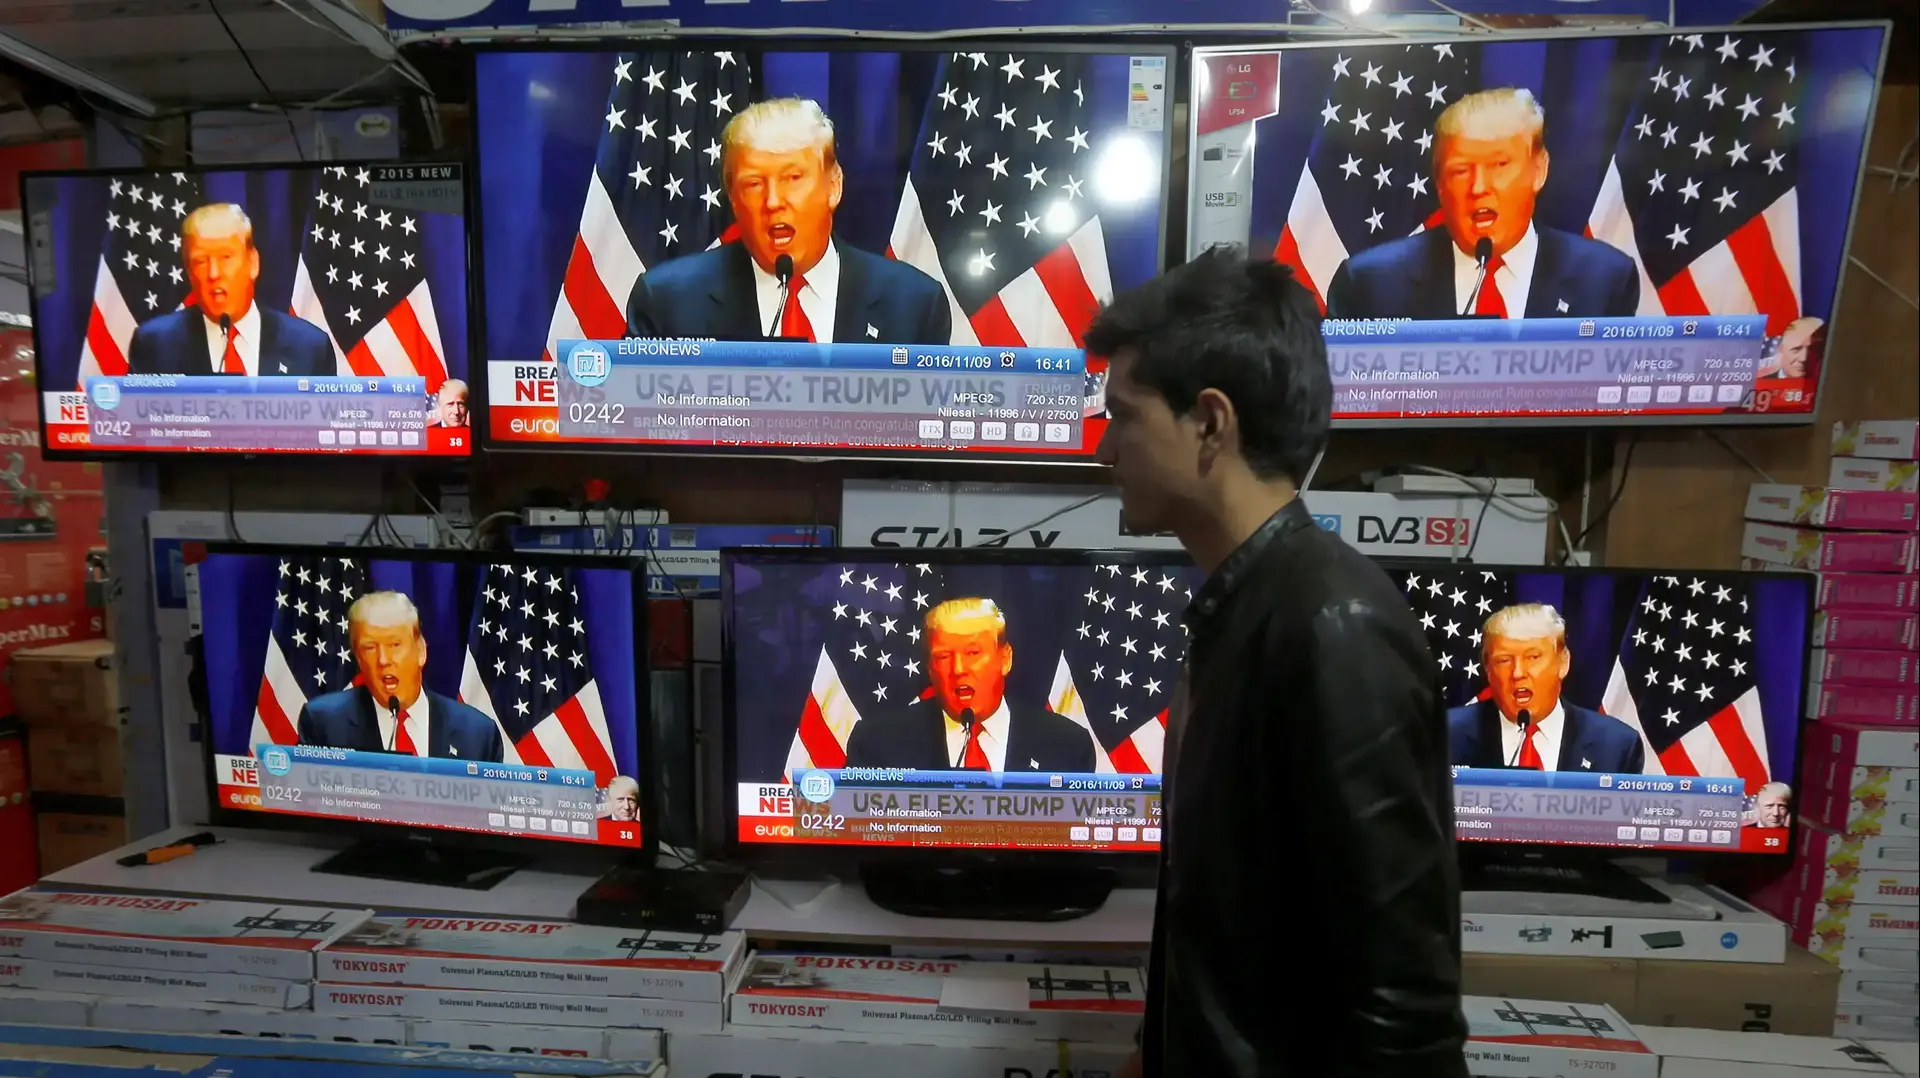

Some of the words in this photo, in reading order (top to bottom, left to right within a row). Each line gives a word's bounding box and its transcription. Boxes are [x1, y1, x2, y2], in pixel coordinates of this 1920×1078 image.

[380, 168, 414, 179] 2015
[421, 167, 452, 178] NEW
[1603, 326, 1674, 338] 2016/11/09
[1716, 325, 1750, 336] 16:41
[618, 344, 700, 356] EURONEWS
[917, 355, 991, 369] 2016/11/09
[1036, 358, 1070, 370] 16:41
[1491, 348, 1593, 375] TRUMP
[1635, 360, 1673, 370] MPEG2
[1704, 359, 1721, 368] 720
[1350, 370, 1366, 380] No
[1372, 368, 1439, 380] Information
[1618, 374, 1654, 384] Nilesat
[1722, 372, 1752, 382] 27500
[315, 383, 364, 394] 2016/11/09
[392, 384, 416, 393] 16:41
[636, 374, 696, 400] USA
[803, 375, 910, 406] TRUMP
[1350, 389, 1366, 400] No
[1370, 388, 1438, 400] Information
[657, 392, 675, 405] No
[680, 394, 750, 407] Information
[954, 393, 994, 404] MPEG2
[1027, 395, 1045, 404] 720
[1058, 396, 1077, 406] 576
[242, 401, 312, 421] TRUMP
[340, 410, 366, 419] MPEG2
[388, 410, 400, 418] 720
[409, 410, 422, 418] 576
[569, 403, 625, 424] 0242
[938, 408, 976, 418] Nilesat
[988, 408, 1018, 418] 11996
[1048, 410, 1078, 420] 27500
[150, 414, 163, 423] No
[164, 414, 210, 424] Information
[657, 412, 675, 426] No
[680, 414, 750, 427] Information
[94, 421, 132, 436] 0242
[402, 422, 424, 430] 27500
[150, 428, 164, 437] No
[165, 428, 211, 438] Information
[450, 438, 462, 446] 38
[1358, 516, 1420, 544] DVB
[1430, 520, 1466, 544] S2
[484, 769, 532, 780] 2016/11/09
[562, 776, 585, 786] 16:41
[840, 772, 904, 781] EURONEWS
[1069, 780, 1125, 790] 2016/11/09
[320, 784, 332, 792] No
[335, 784, 380, 796] Information
[412, 778, 481, 802] TRUMP
[1618, 780, 1674, 791] 2016/11/09
[1706, 784, 1732, 793] 16:41
[266, 786, 302, 802] 0242
[322, 797, 334, 806] No
[336, 798, 380, 810] Information
[509, 796, 536, 805] MPEG2
[578, 802, 592, 810] 576
[854, 793, 898, 812] USA
[982, 796, 1064, 817] TRUMP
[1534, 794, 1612, 816] TRUMP
[572, 812, 593, 820] 27500
[870, 808, 884, 817] No
[887, 808, 942, 818] Information
[1097, 807, 1128, 815] MPEG2
[1645, 808, 1674, 816] MPEG2
[1722, 810, 1737, 818] 576
[801, 814, 844, 830] 0242
[870, 823, 884, 832] No
[887, 823, 942, 833] Information
[1085, 818, 1114, 826] Nilesat
[1122, 818, 1146, 826] 11996
[1713, 820, 1738, 828] 27500
[620, 831, 633, 840] 38
[1764, 838, 1779, 846] 38
[50, 893, 198, 912] TOKYOSAT
[404, 917, 562, 935] TOKYOSAT
[332, 960, 406, 974] TOKYOSAT
[440, 966, 475, 975] Universal
[540, 972, 564, 982] Tilting
[585, 974, 608, 983] Mount
[794, 956, 957, 974] TOKYOSAT
[330, 992, 404, 1006] TOKYOSAT
[439, 998, 474, 1007] Universal
[539, 1002, 564, 1014] Tilting
[567, 1004, 583, 1012] Wall
[584, 1005, 608, 1014] Mount
[748, 1003, 826, 1017] TOKYOSAT
[862, 1010, 898, 1019] Universal
[900, 1012, 964, 1022] Plasma/LCD/LED
[994, 1016, 1010, 1024] Wall
[1483, 1053, 1500, 1061] Wall
[1503, 1054, 1530, 1063] Mount
[1569, 1059, 1616, 1070] TS-3270TB
